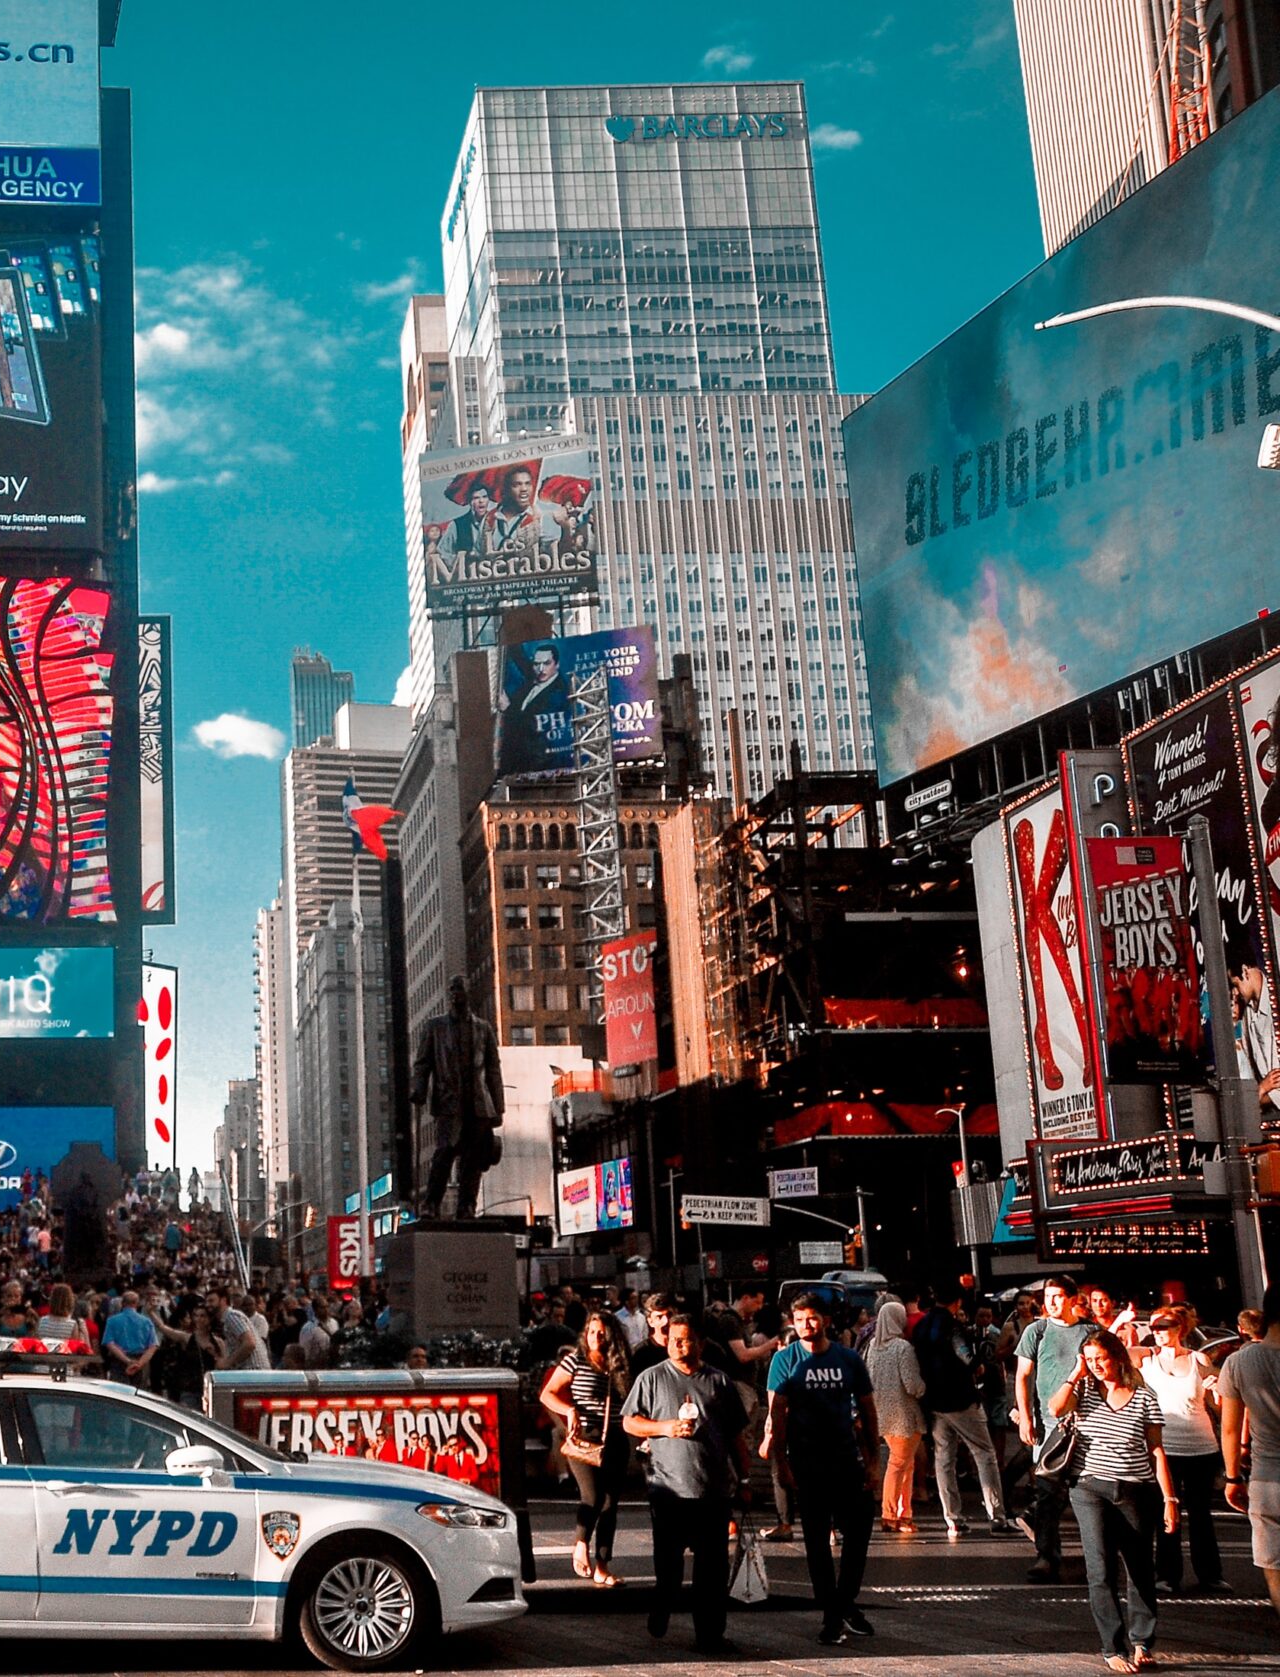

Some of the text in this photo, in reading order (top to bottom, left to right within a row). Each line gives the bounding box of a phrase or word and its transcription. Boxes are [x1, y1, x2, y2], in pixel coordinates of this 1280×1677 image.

[642, 115, 787, 139] BARCLAYS
[423, 464, 453, 476] FINAL
[455, 455, 500, 469] MONTHS
[12, 513, 46, 523] Schmidt
[47, 515, 59, 523] on
[59, 514, 86, 524] Netflix
[430, 539, 592, 586] Misérables
[502, 580, 539, 590] IMPERIAL
[540, 576, 579, 585] THEATRE
[576, 645, 639, 661] LET YOUR
[535, 699, 655, 732] PHOM
[546, 728, 563, 740] OF
[1154, 714, 1209, 770] Winner!
[1157, 752, 1207, 791] 4 TONY AWARDS
[1153, 797, 1178, 825] Best
[1180, 767, 1227, 806] Musical!
[1100, 875, 1183, 927] JERSEY
[1113, 921, 1177, 969] BOYS
[15, 1020, 41, 1028] AUTO
[42, 1019, 71, 1028] SHOW
[1070, 1111, 1086, 1123] BEST
[685, 1199, 757, 1210] PEDESTRIAN FLOW ZONE
[718, 1211, 758, 1222] KEEP MOVING
[442, 1272, 488, 1283] GEORGE
[805, 1368, 843, 1381] ANU
[393, 1408, 488, 1465] BOYS
[52, 1508, 239, 1557] NYPD
